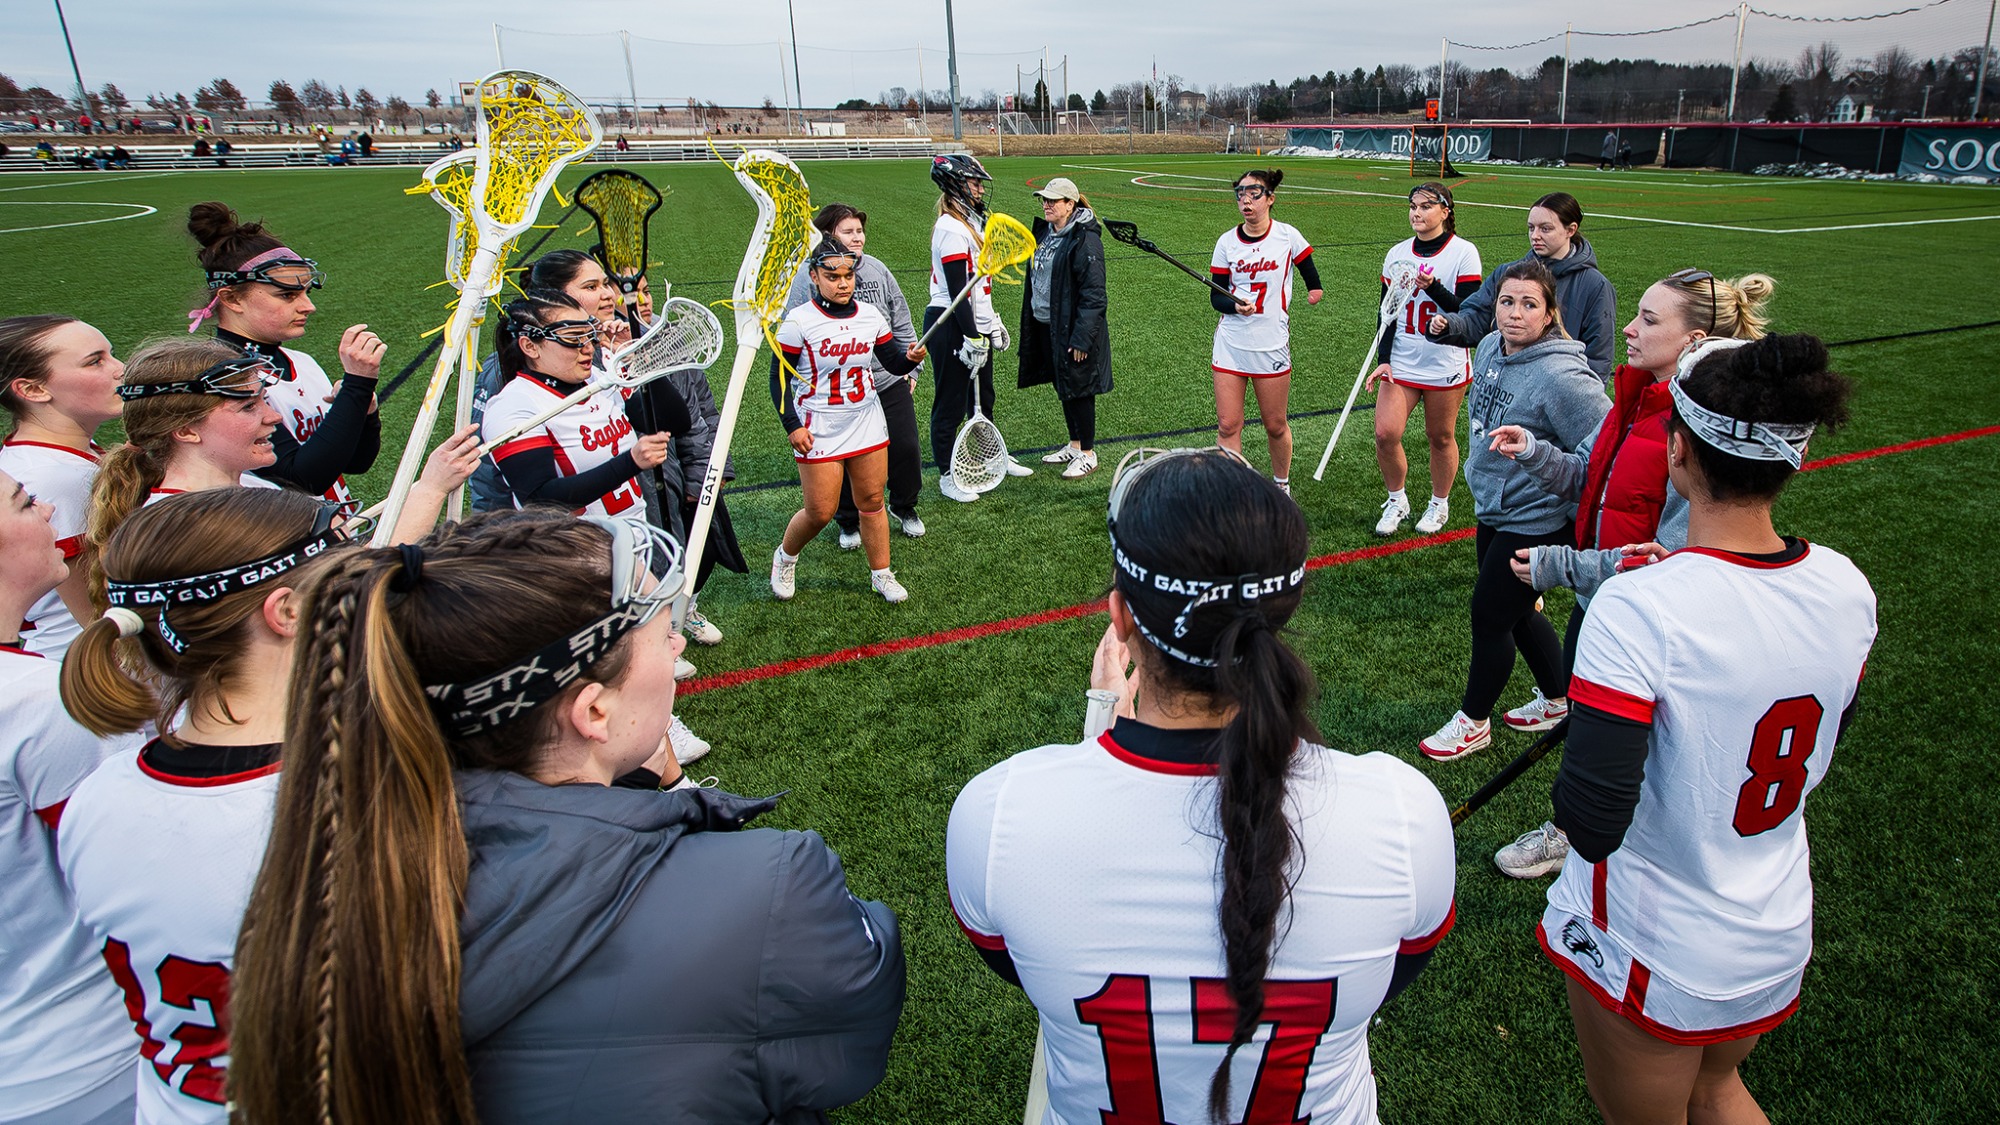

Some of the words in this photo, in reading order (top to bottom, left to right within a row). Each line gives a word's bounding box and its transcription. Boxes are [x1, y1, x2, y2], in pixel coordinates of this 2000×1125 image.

[1391, 135, 1481, 155] EDGEWOOD
[213, 271, 238, 279] STX
[1235, 257, 1279, 280] Eagles
[1250, 282, 1267, 314] 7
[1405, 300, 1437, 335] 16
[820, 338, 871, 365] Eagles
[828, 366, 866, 405] 13
[579, 414, 632, 457] Eagles
[1692, 406, 1733, 431] STX
[1700, 427, 1744, 454] STX
[701, 464, 719, 506] GAIT
[135, 590, 167, 604] GA
[241, 554, 296, 585] GAIT
[304, 538, 327, 557] GA
[1116, 548, 1148, 582] GAIT
[1193, 584, 1233, 608] AIT
[1242, 575, 1285, 599] GIT
[463, 655, 549, 706] STX
[568, 605, 641, 658] STX
[1732, 693, 1825, 838] 8
[1073, 973, 1339, 1125] 17
